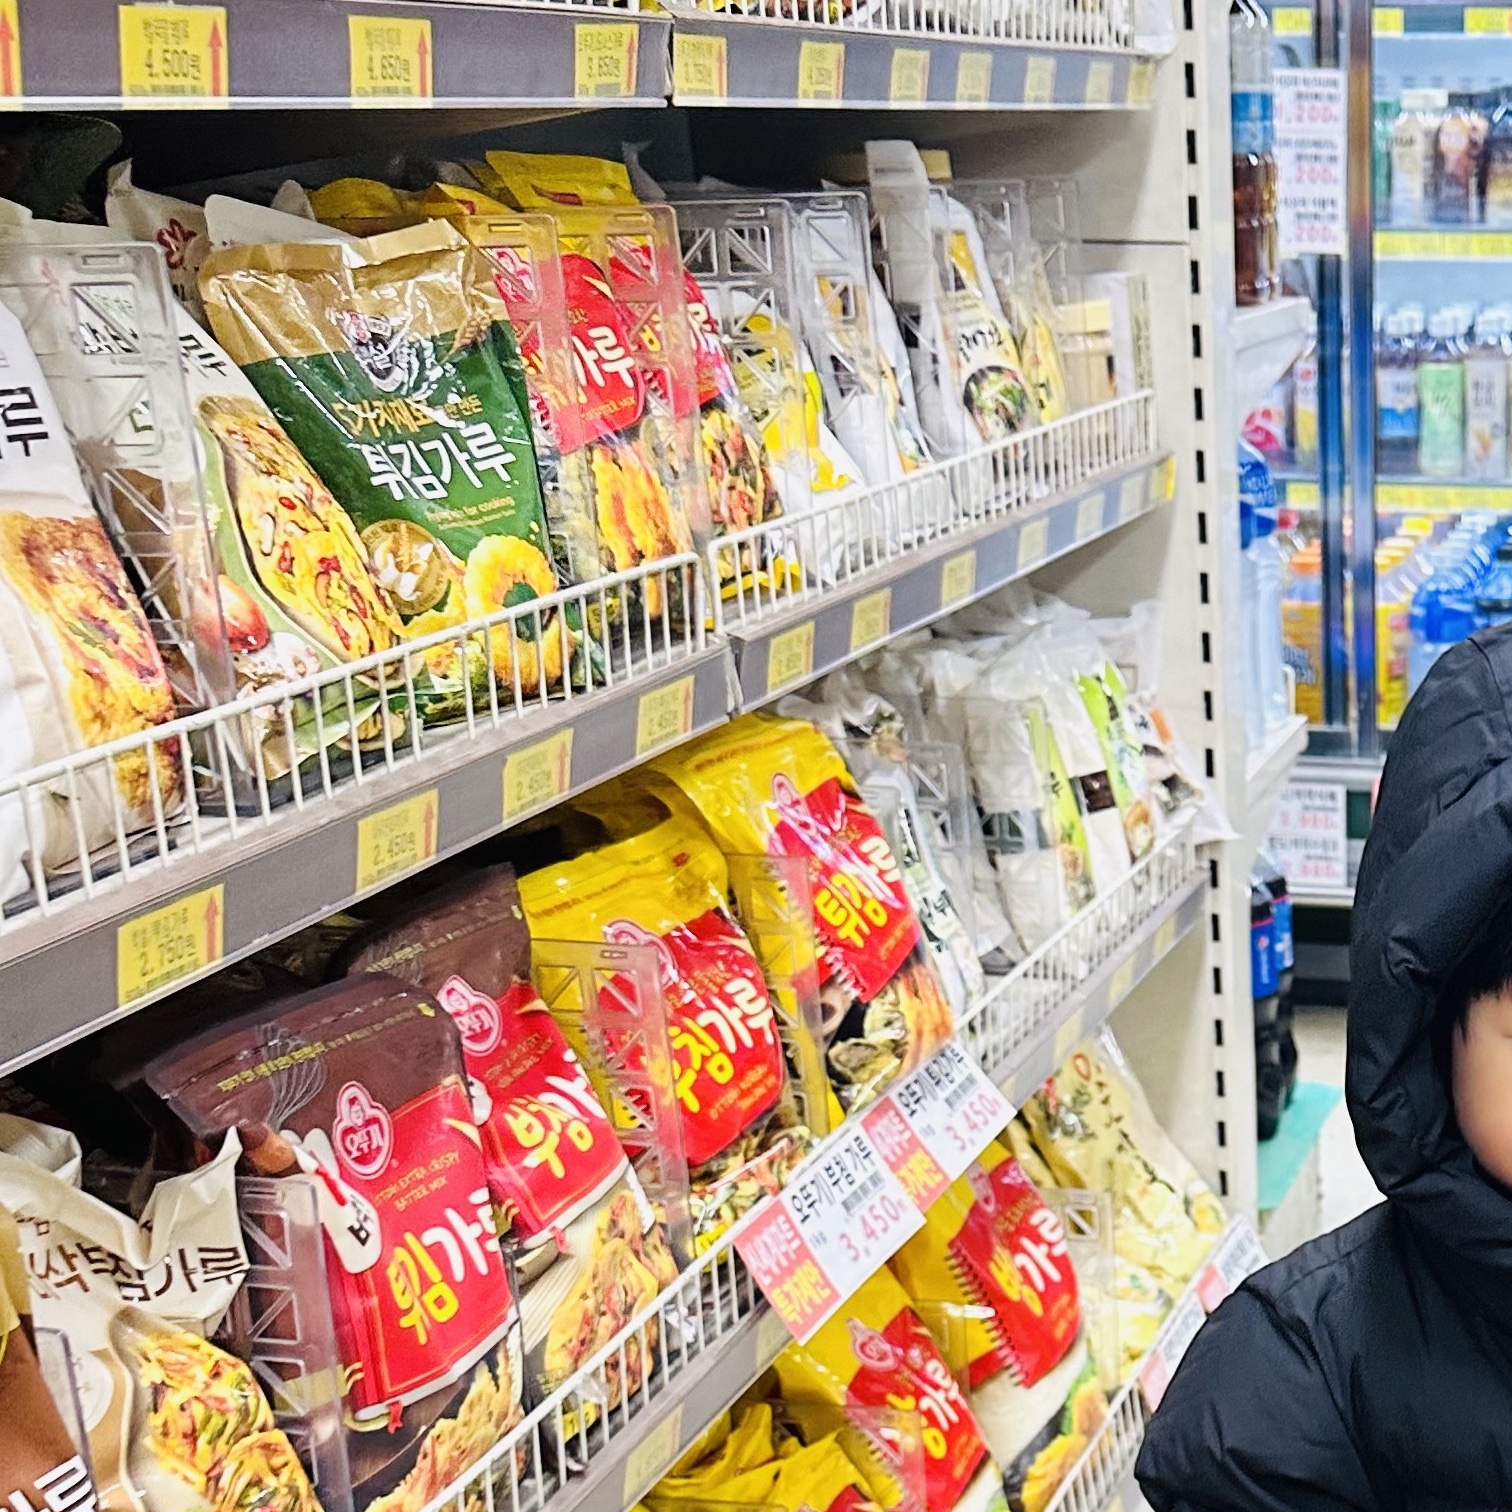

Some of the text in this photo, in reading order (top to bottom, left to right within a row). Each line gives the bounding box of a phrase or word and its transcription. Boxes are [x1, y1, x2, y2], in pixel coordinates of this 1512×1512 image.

[360, 421, 517, 502] 튀김가루
[344, 1121, 385, 1161] 오뚜기
[502, 1049, 610, 1180] 부침가
